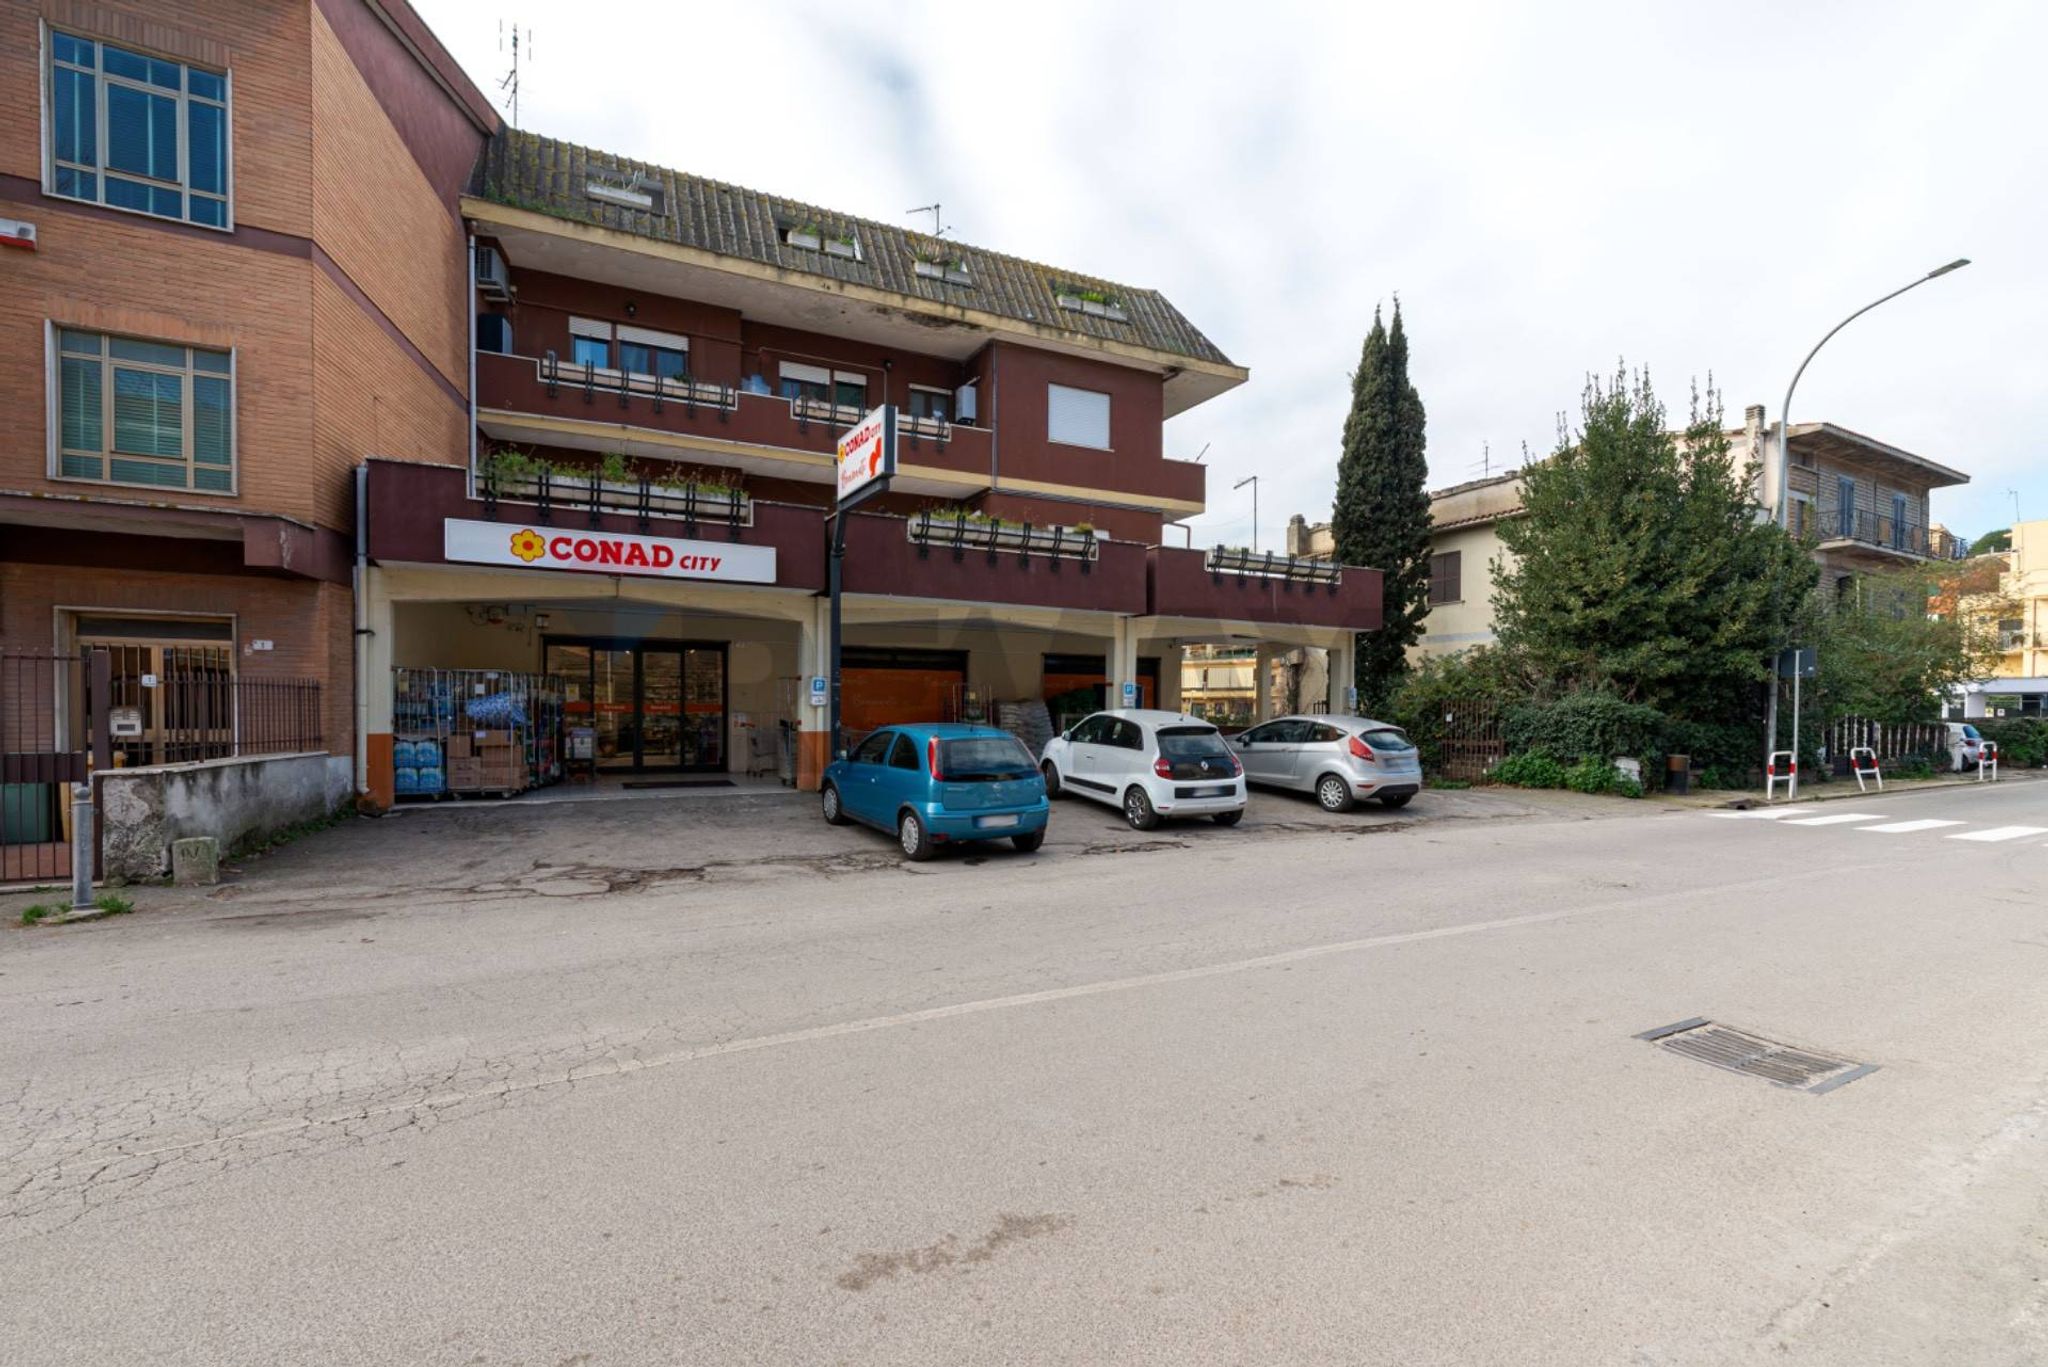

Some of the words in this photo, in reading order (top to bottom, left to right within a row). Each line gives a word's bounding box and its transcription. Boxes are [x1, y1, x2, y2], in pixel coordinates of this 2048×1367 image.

[846, 427, 869, 456] CONAD
[550, 537, 674, 568] CONAD
[679, 555, 721, 571] CITY
[816, 681, 823, 690] P
